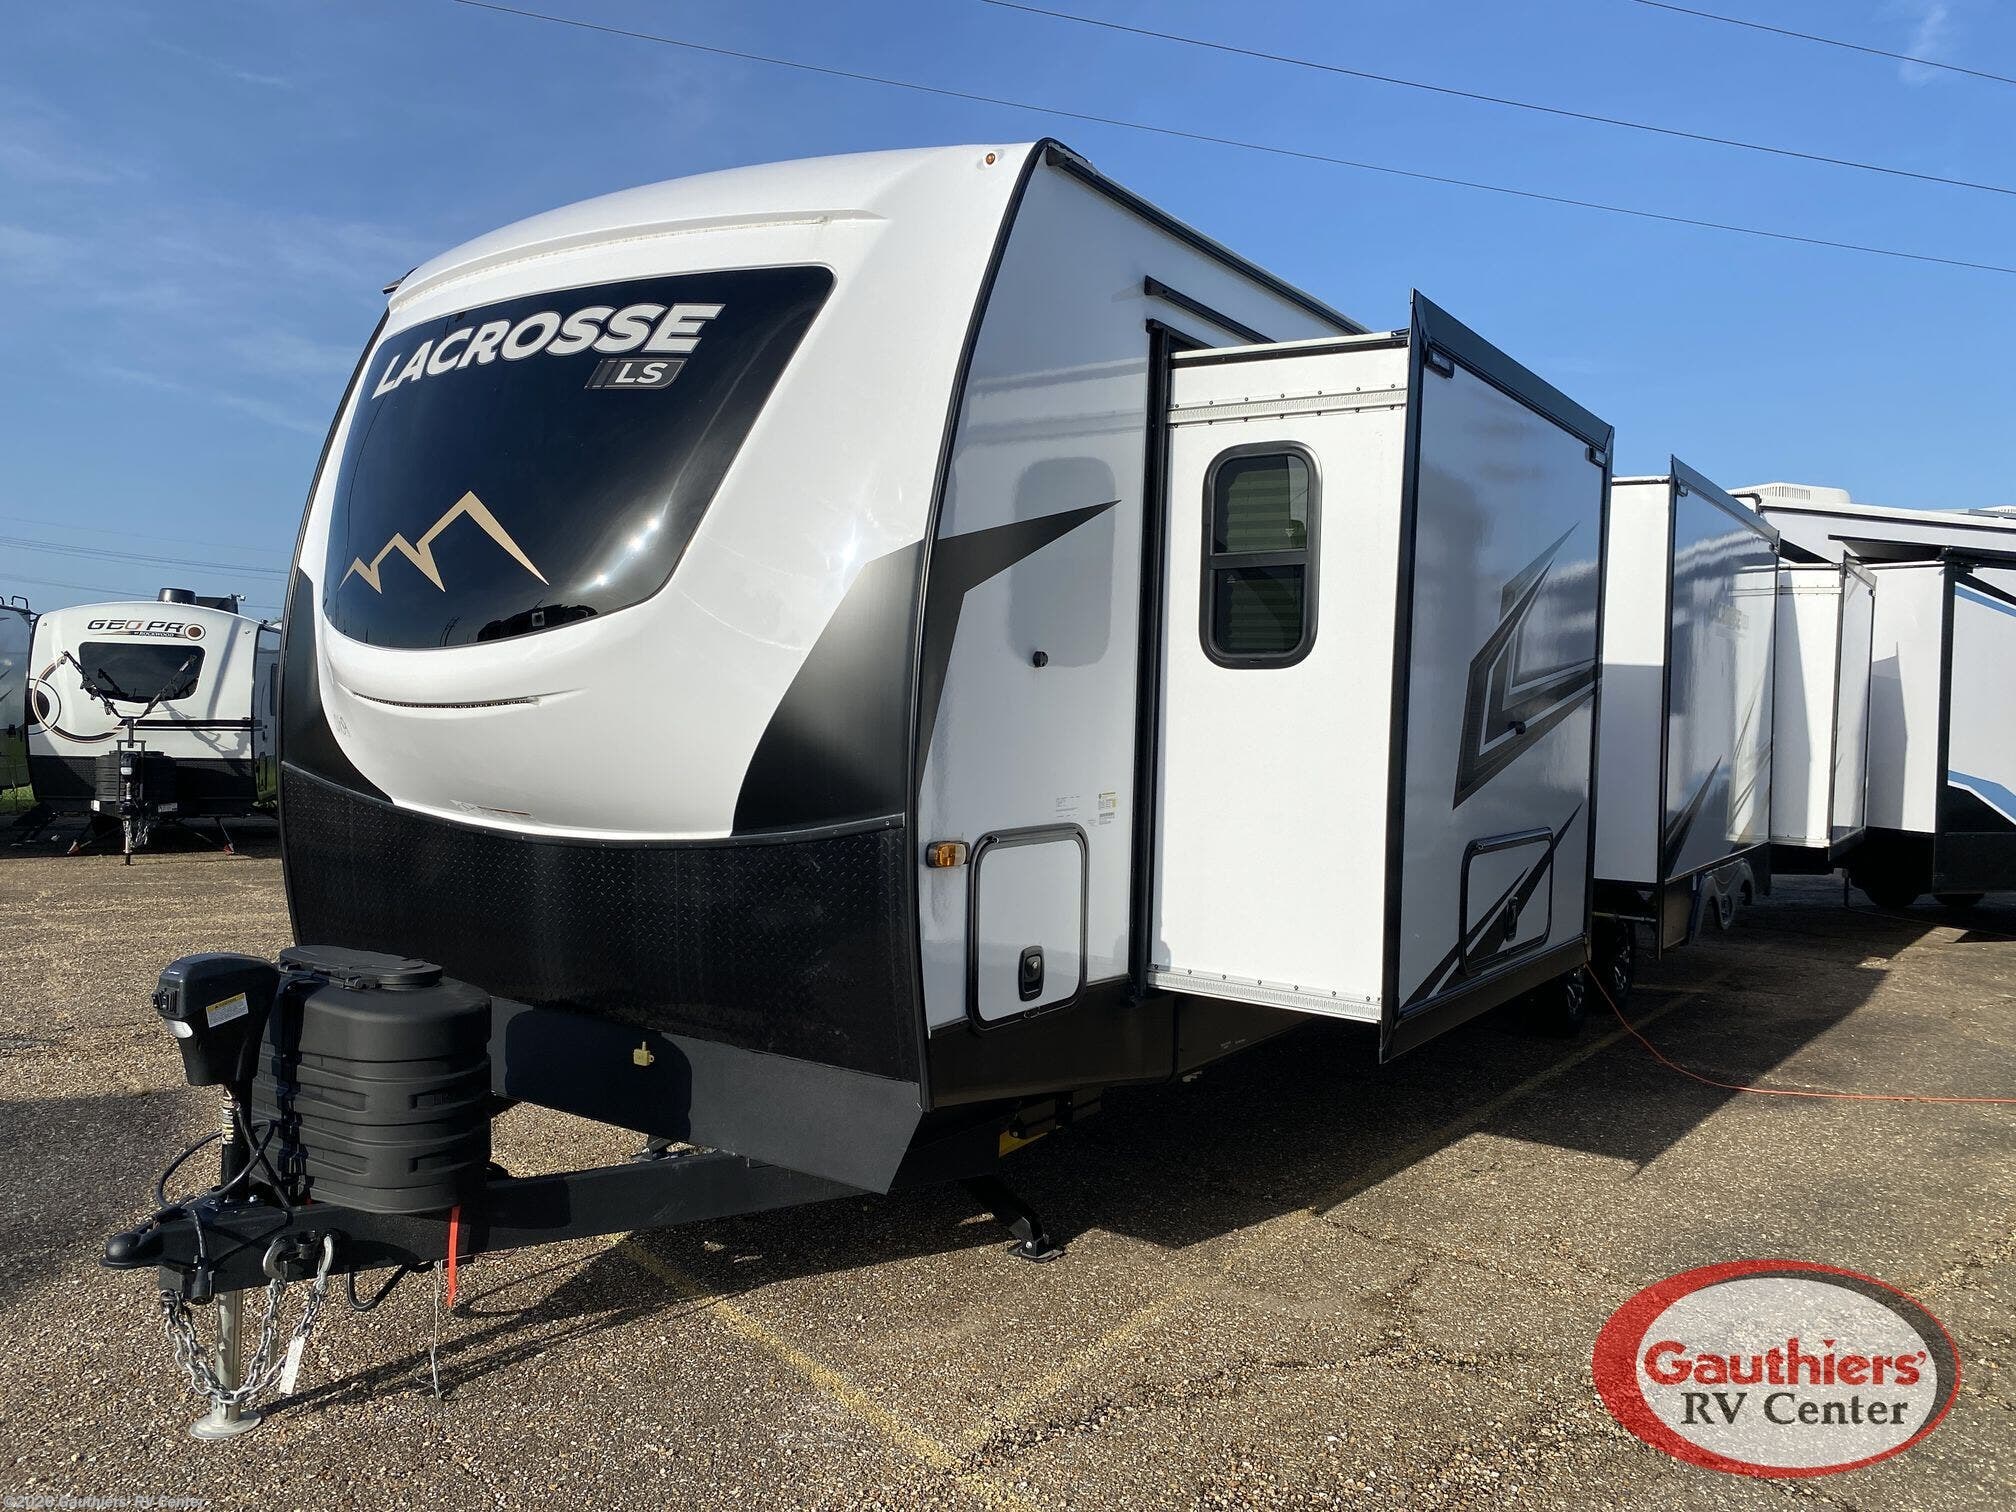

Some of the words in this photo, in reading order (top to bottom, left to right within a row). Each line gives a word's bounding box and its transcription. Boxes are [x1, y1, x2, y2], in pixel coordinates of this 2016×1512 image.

[371, 303, 726, 400] LACROSSE
[614, 361, 667, 384] LS
[87, 619, 144, 630] GEO
